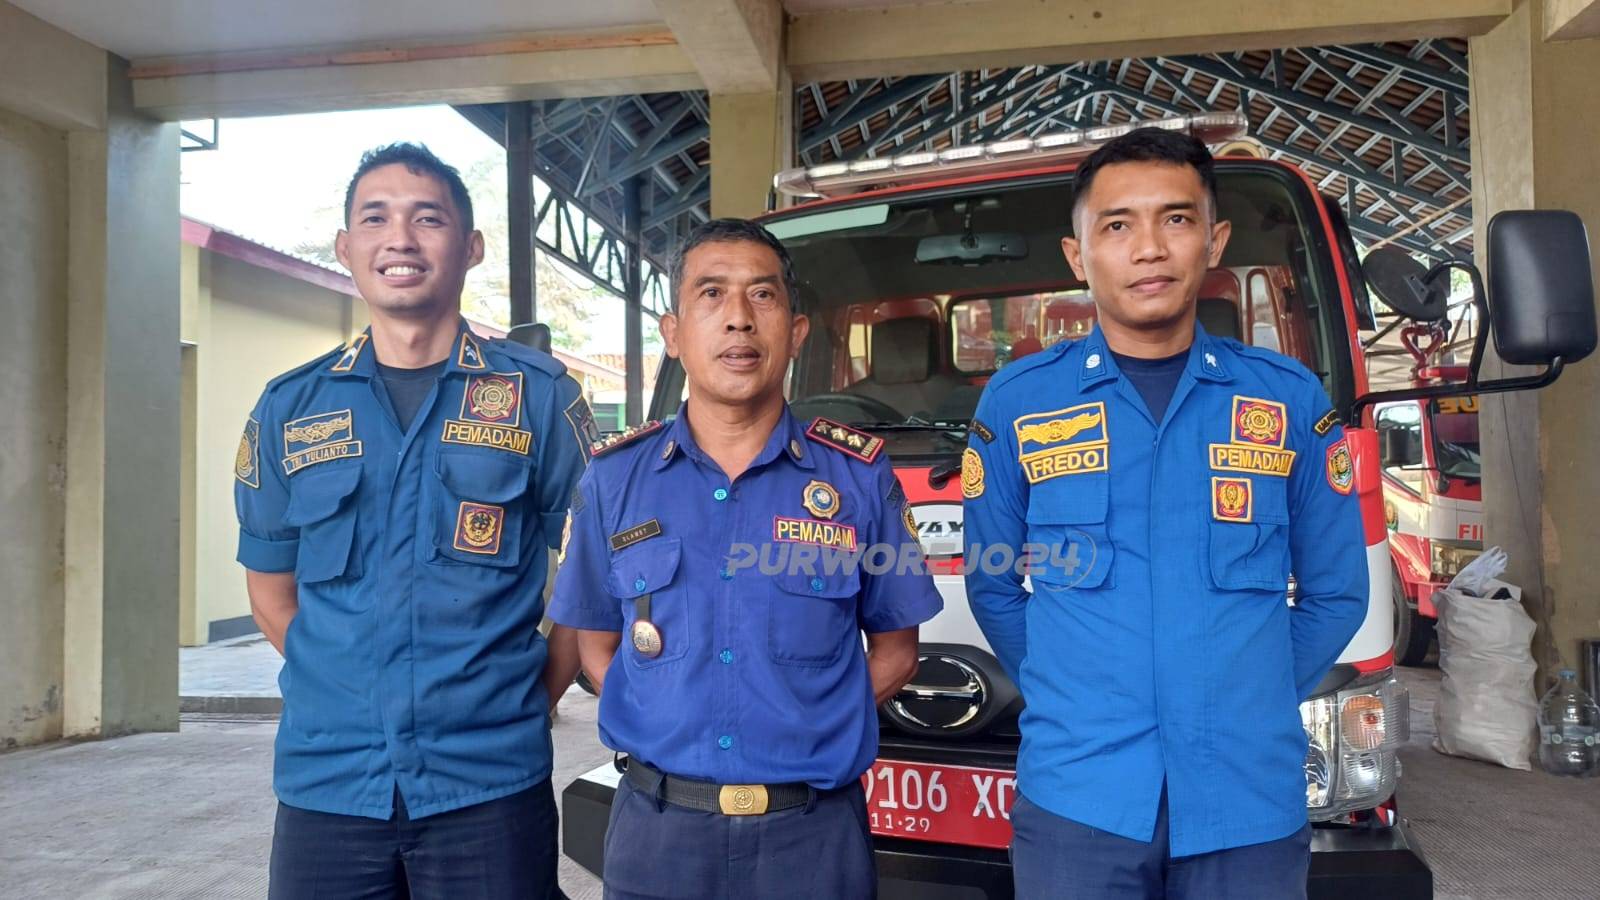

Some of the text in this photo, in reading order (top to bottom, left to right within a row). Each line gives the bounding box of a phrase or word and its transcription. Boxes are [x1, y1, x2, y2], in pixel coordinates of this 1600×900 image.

[446, 423, 527, 451] PEMADAM
[305, 445, 348, 462] YULIANTO
[1030, 451, 1100, 478] FREDO
[1216, 448, 1291, 474] PEMADAM
[777, 520, 854, 549] PEMADAM
